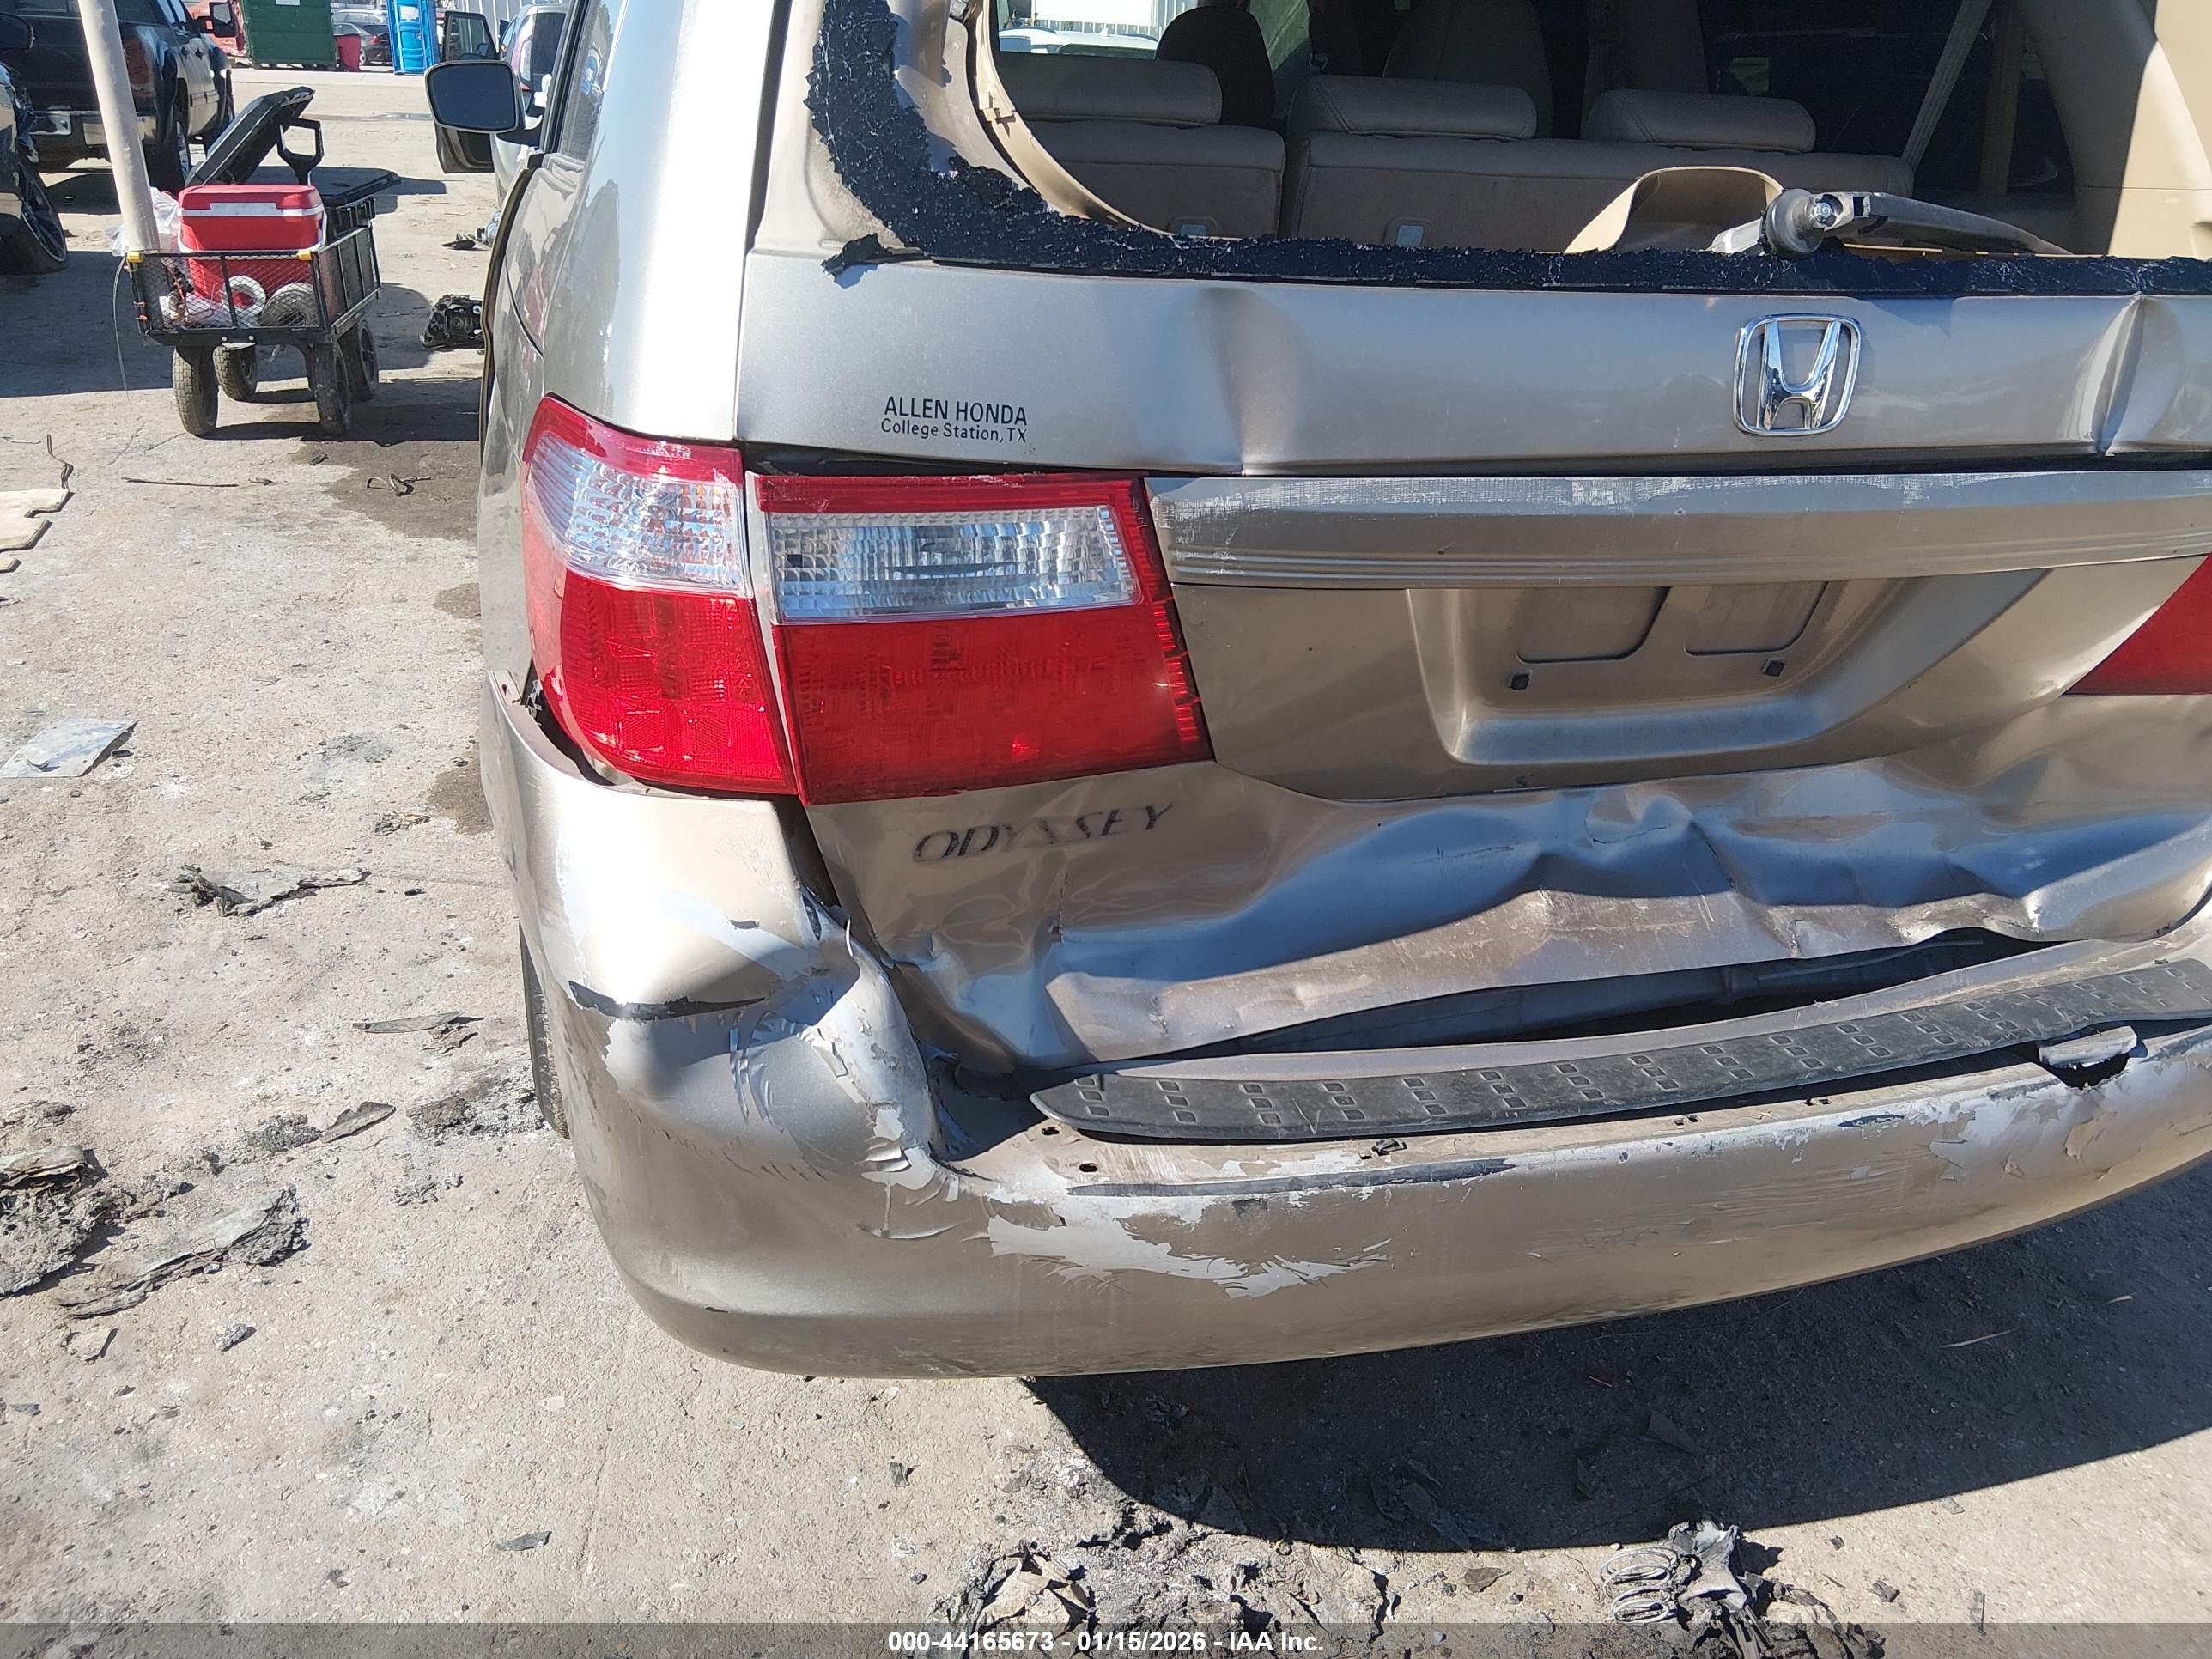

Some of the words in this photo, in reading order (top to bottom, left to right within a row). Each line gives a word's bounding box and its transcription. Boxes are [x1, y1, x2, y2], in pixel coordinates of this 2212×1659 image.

[884, 395, 949, 420] ALLEN
[956, 400, 1028, 426] HONDA
[880, 417, 939, 440] College
[943, 422, 1004, 444] Station,
[1006, 427, 1027, 443] TX
[913, 802, 1174, 865] ODYSSEY
